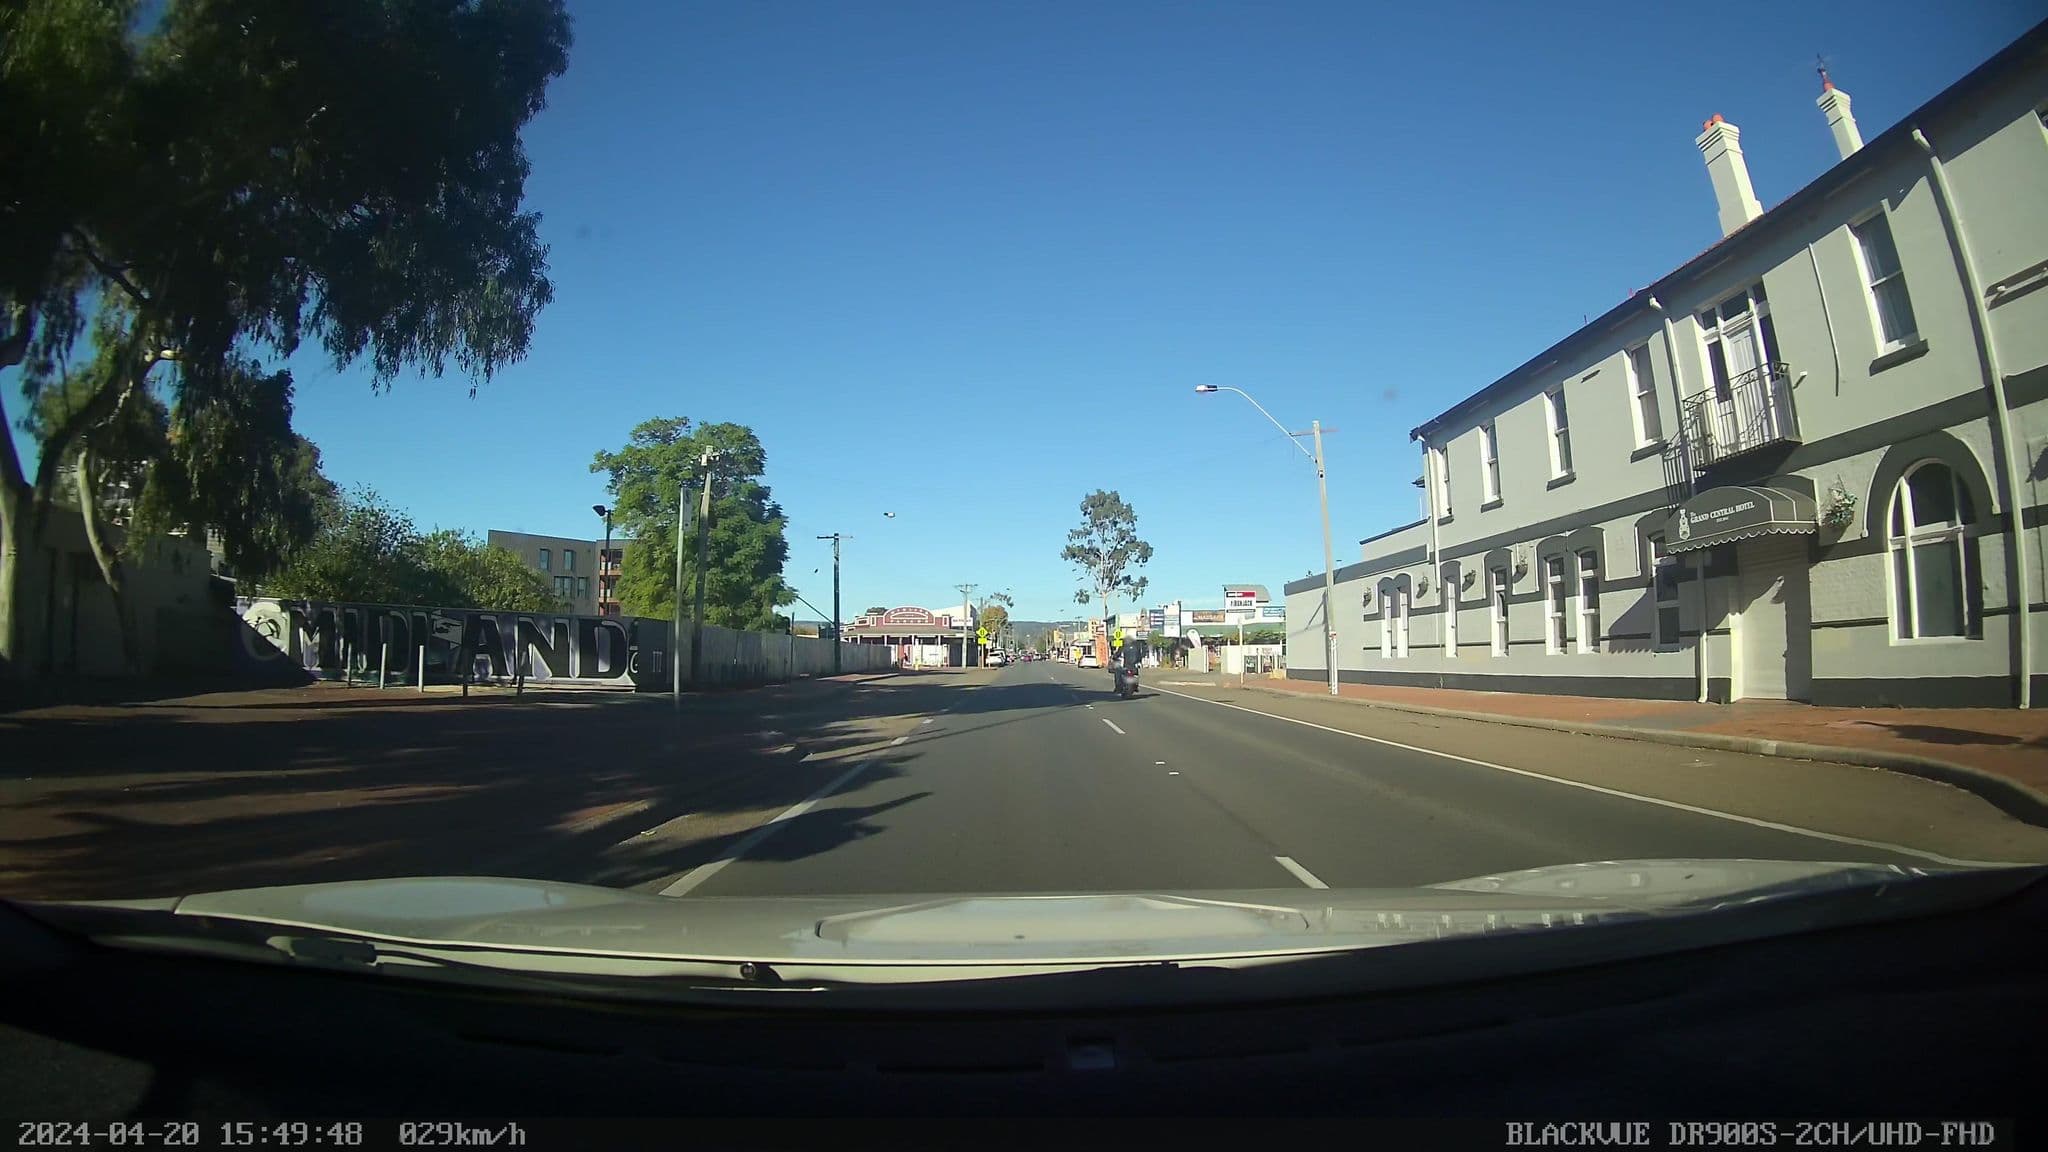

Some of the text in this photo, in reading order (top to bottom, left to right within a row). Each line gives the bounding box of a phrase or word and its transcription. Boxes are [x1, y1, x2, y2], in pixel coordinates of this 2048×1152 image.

[1690, 513, 1709, 523] GRAND
[1710, 506, 1735, 518] CENTRAL
[1735, 501, 1755, 512] HOTEL
[289, 602, 629, 681] MIDLAND
